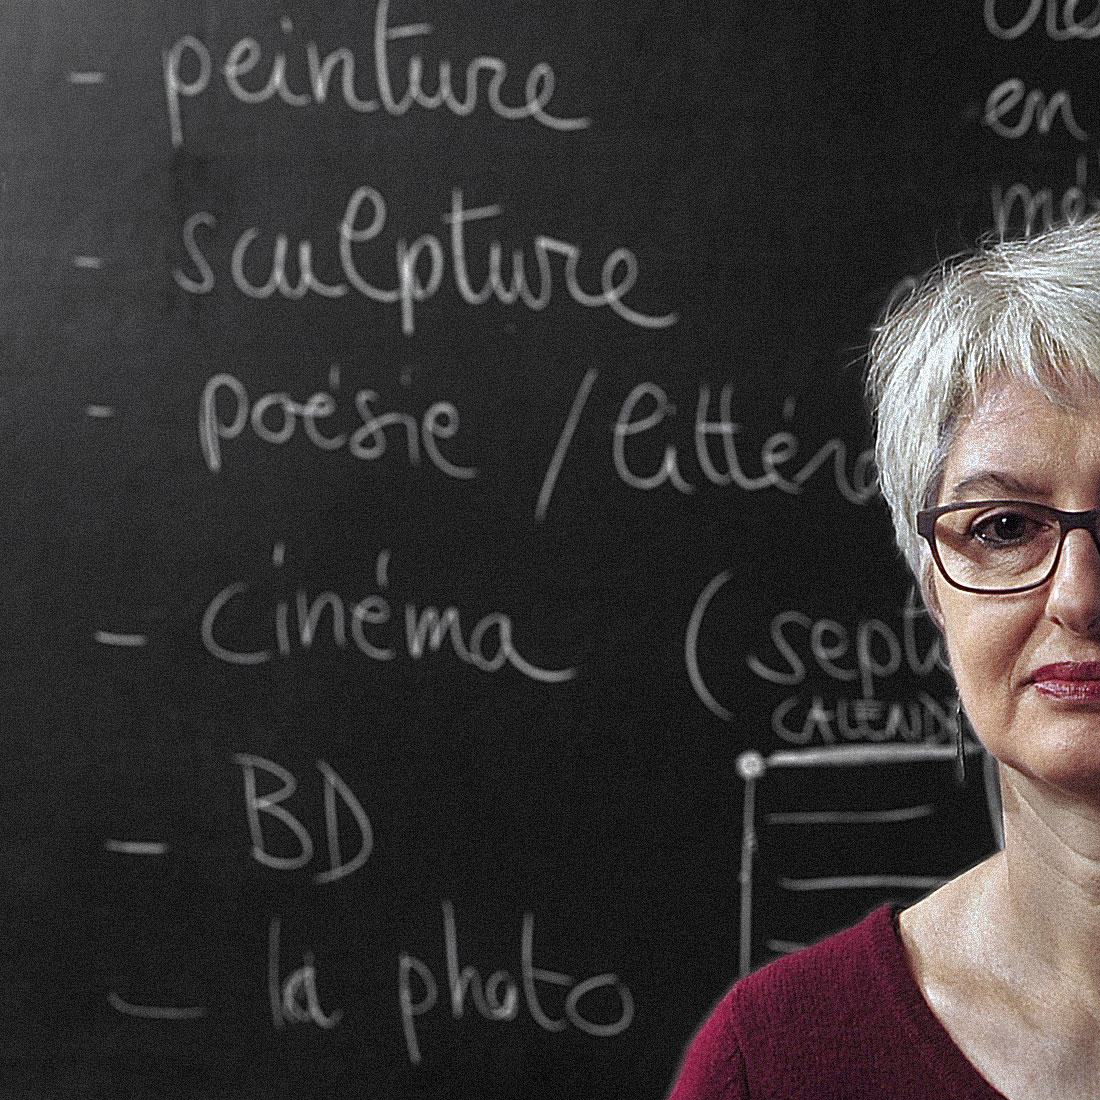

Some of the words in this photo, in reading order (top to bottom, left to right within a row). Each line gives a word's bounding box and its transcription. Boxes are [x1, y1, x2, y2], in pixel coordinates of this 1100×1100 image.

[163, 0, 591, 145] peinture
[983, 77, 1086, 139] en
[175, 186, 678, 336] sculpture
[198, 367, 476, 479] poésie
[234, 754, 374, 883] BD
[269, 922, 341, 1029] la
[398, 902, 634, 1063] photo
